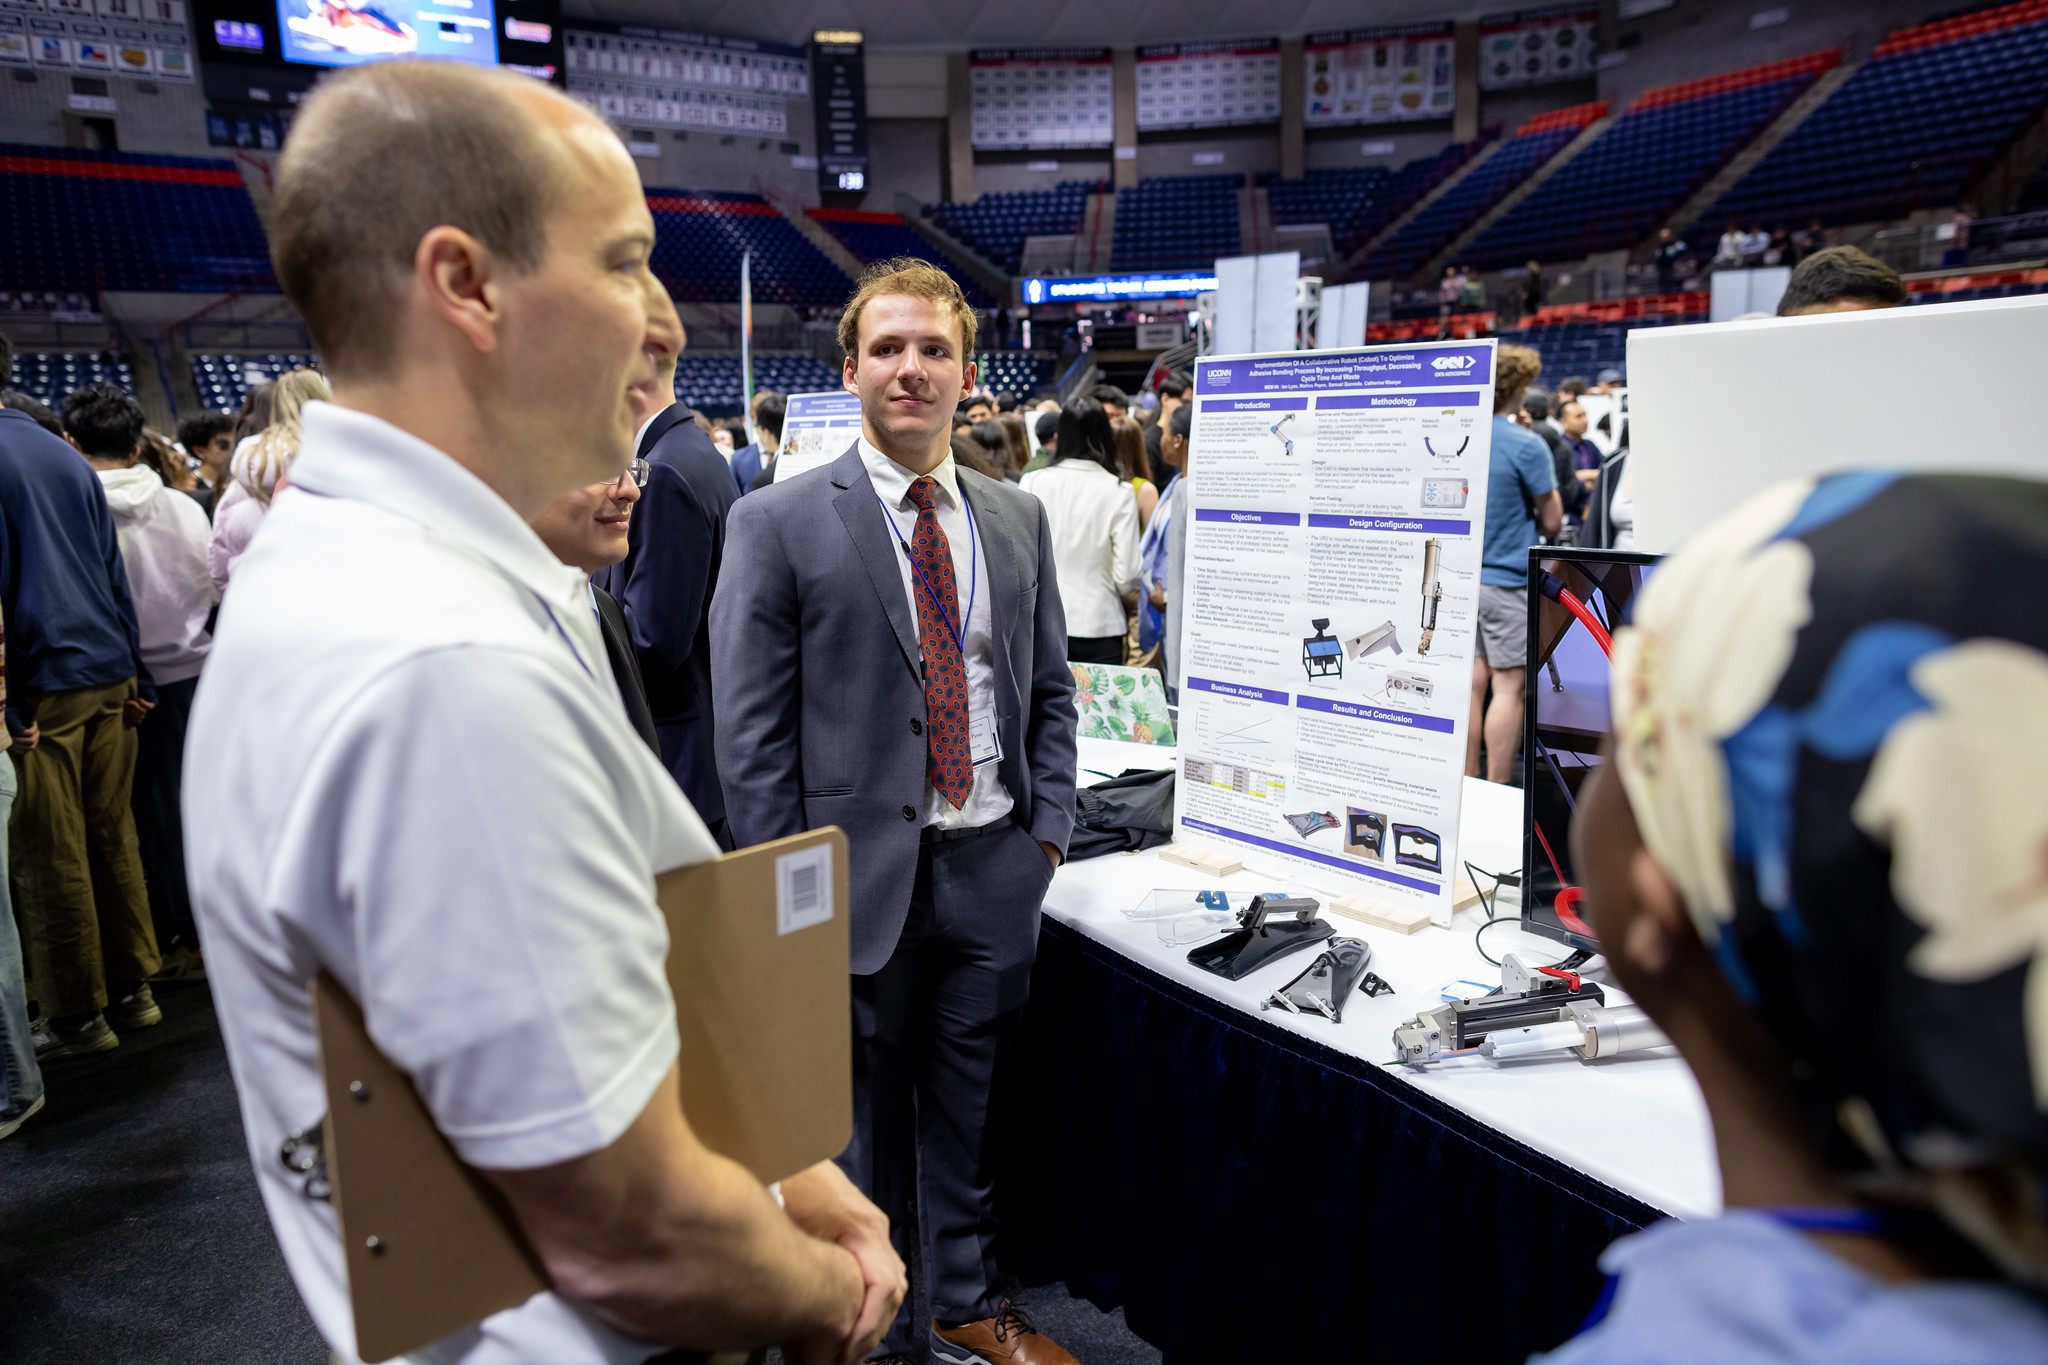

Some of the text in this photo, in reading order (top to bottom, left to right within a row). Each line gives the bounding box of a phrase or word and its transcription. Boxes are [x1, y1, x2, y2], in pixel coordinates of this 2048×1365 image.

[1255, 360, 1292, 369] Implementation
[1273, 368, 1293, 376] Bonding
[1316, 366, 1323, 374] By
[1324, 365, 1352, 374] Increasing
[1354, 363, 1387, 373] Throughput,
[1389, 362, 1421, 371] Decreasing
[1301, 374, 1315, 383] Cycle
[1371, 397, 1417, 407] Methodology
[1231, 513, 1261, 522] Objectives
[1349, 519, 1423, 530] Design Configuration
[1211, 683, 1262, 698] Business Analysis
[1333, 704, 1357, 714] Results
[1373, 711, 1412, 724] Conclusion
[1387, 778, 1408, 788] decreasing
